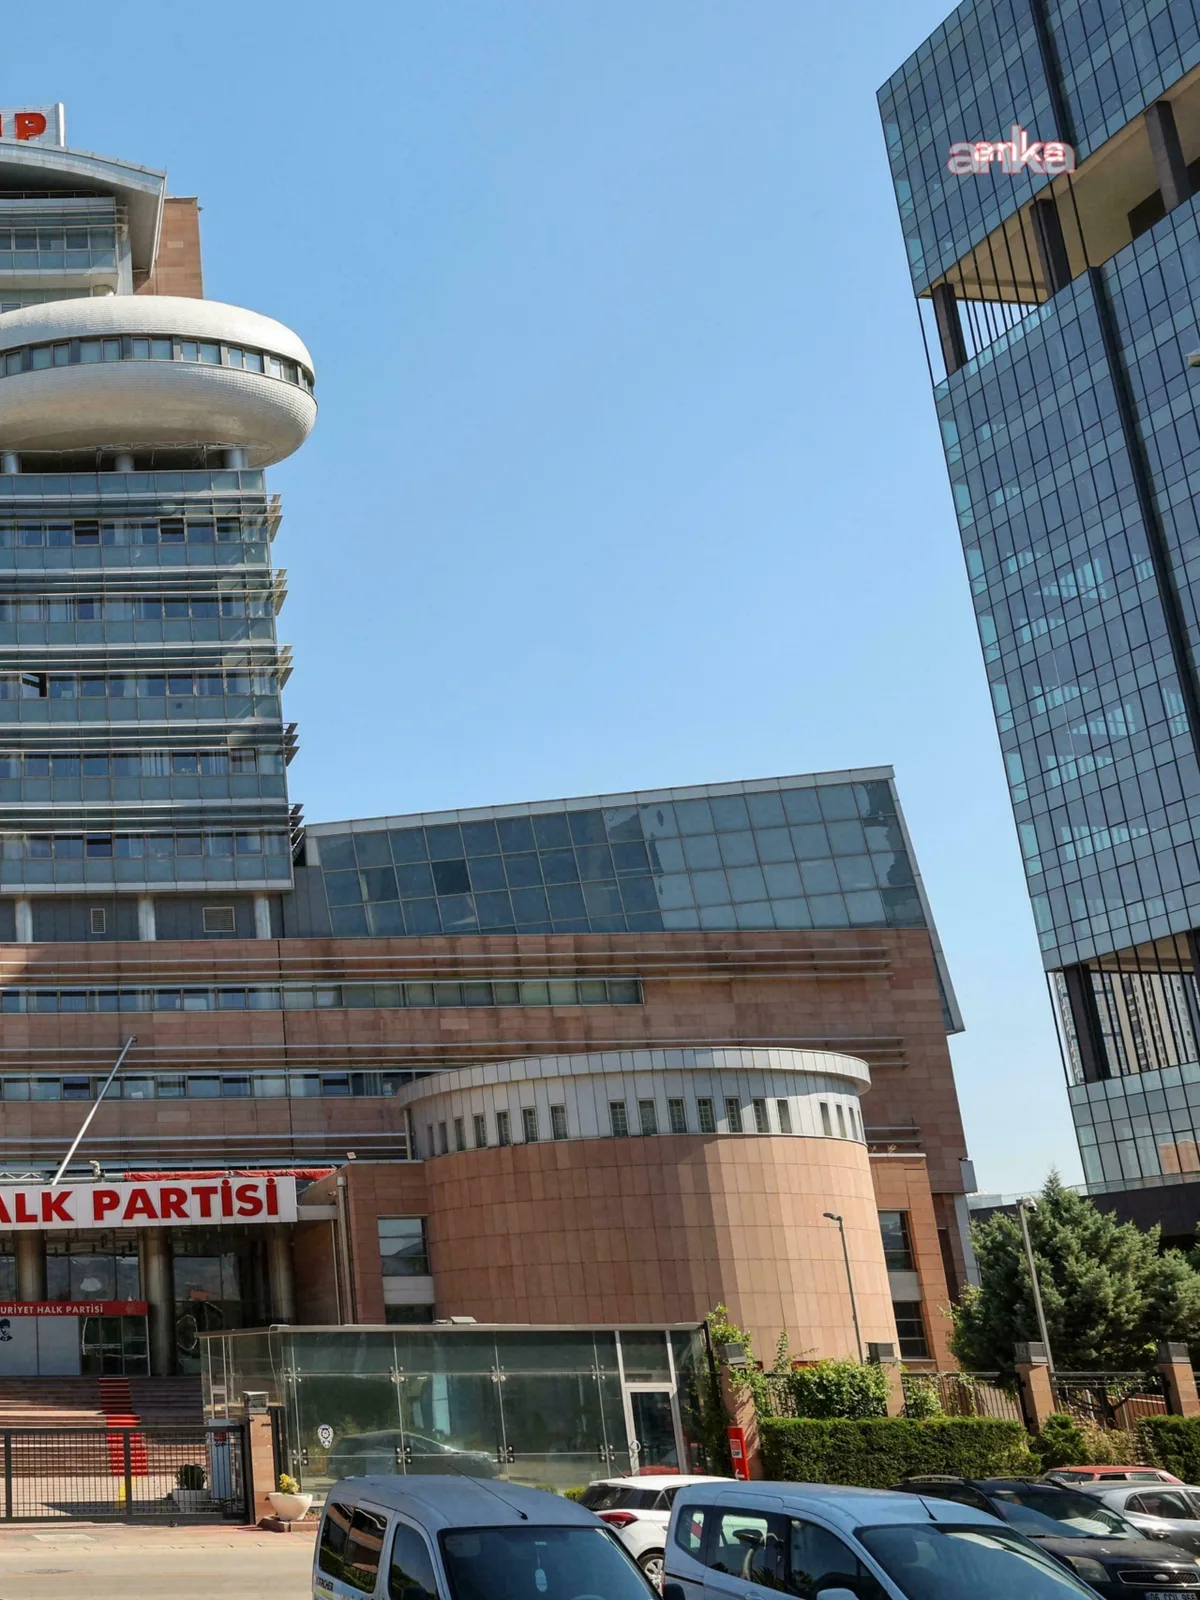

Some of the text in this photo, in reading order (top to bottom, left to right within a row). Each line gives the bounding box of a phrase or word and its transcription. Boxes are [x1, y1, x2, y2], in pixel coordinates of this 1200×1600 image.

[92, 1177, 279, 1221] PARTİSİ
[37, 1305, 62, 1314] HALK
[66, 1303, 104, 1314] PARTİSİ
